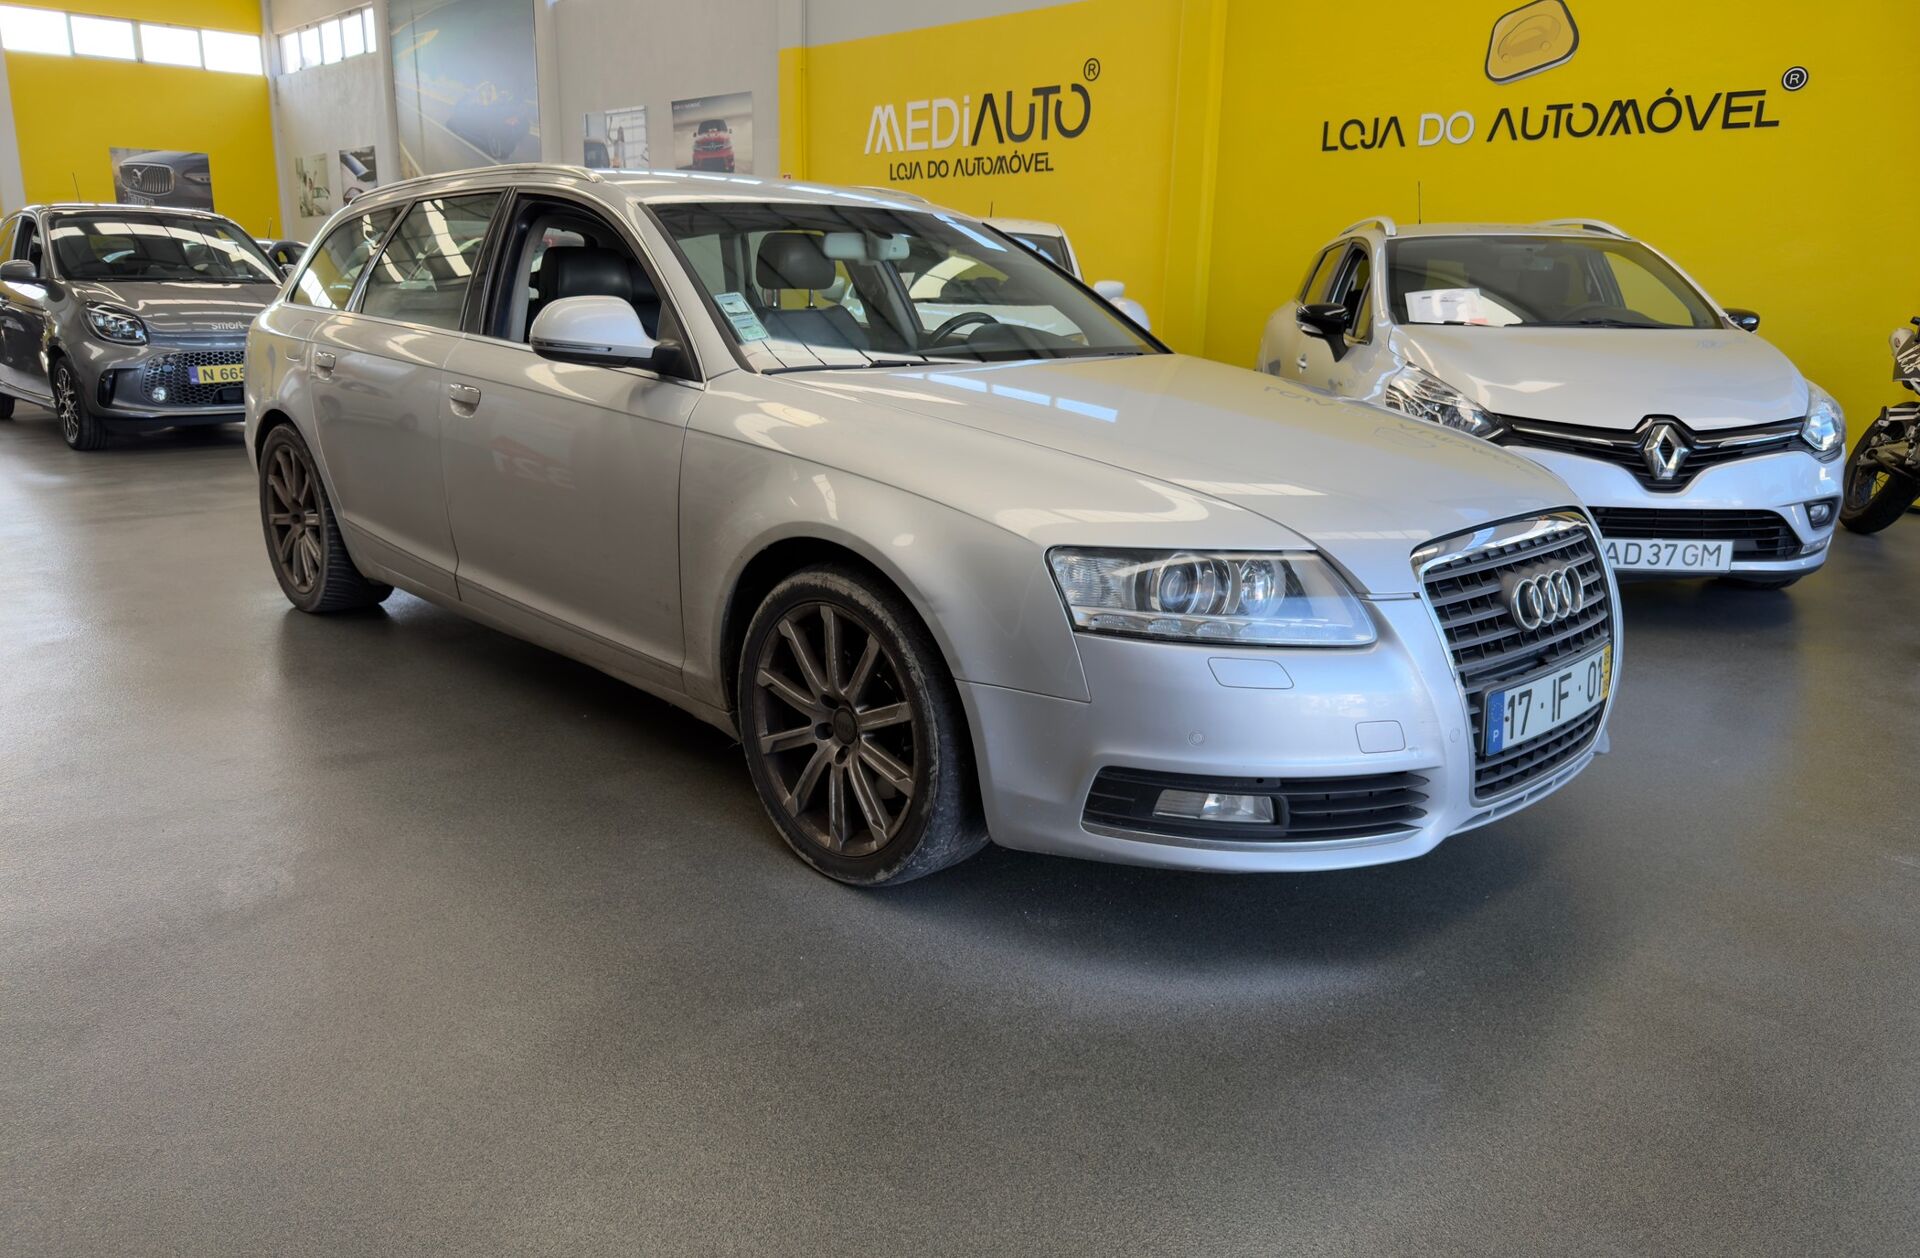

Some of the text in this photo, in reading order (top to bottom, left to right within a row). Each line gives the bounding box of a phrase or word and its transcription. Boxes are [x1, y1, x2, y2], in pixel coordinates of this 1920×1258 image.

[1321, 115, 1406, 152] LOJA
[1418, 111, 1476, 147] DO
[1486, 87, 1780, 143] AUTOMÓVEL
[889, 149, 1054, 181] LOJA DO AUTOMÓVEL
[211, 320, 245, 330] smart
[1492, 728, 1500, 743] P
